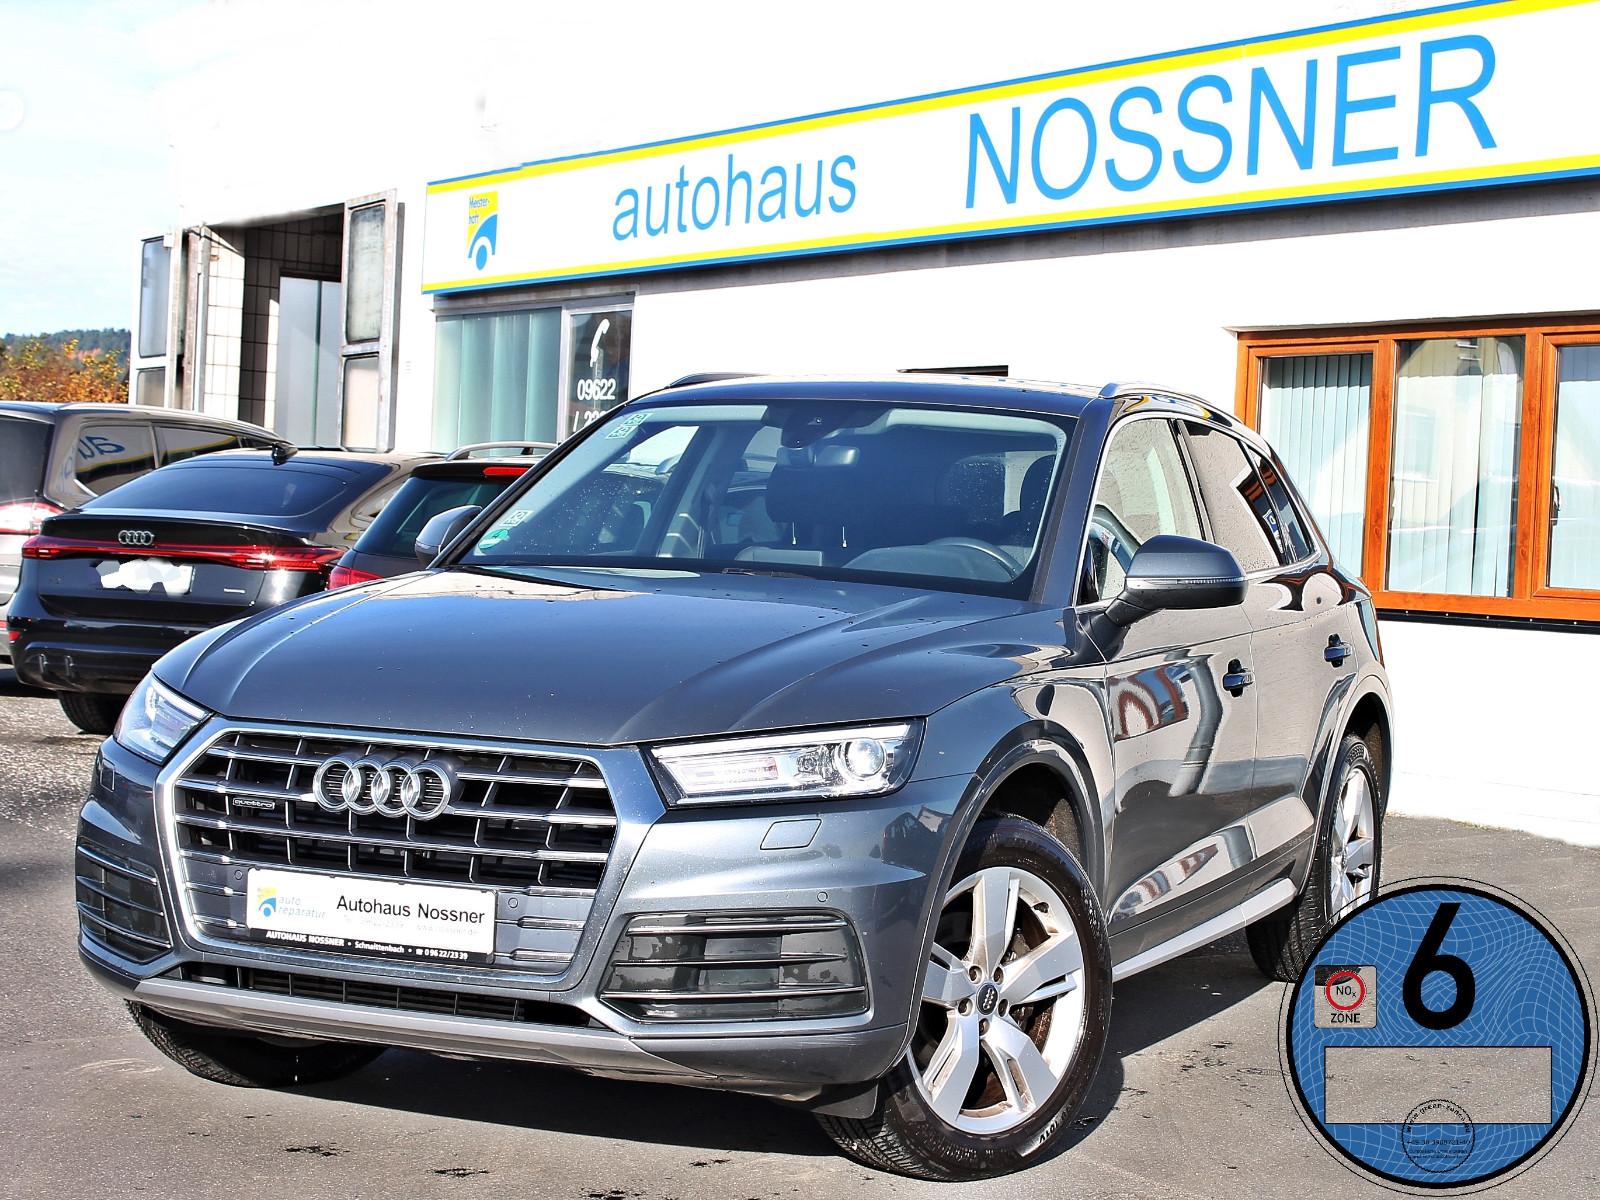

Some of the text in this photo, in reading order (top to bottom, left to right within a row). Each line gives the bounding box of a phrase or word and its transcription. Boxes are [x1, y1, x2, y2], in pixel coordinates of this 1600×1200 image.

[613, 34, 1497, 241] autohaus NOSSNER
[577, 378, 616, 400] 09622
[336, 895, 411, 917] Autohaus
[417, 903, 485, 924] Nossner
[266, 930, 308, 943] AUTOHAUS
[308, 935, 345, 947] NOSSNER
